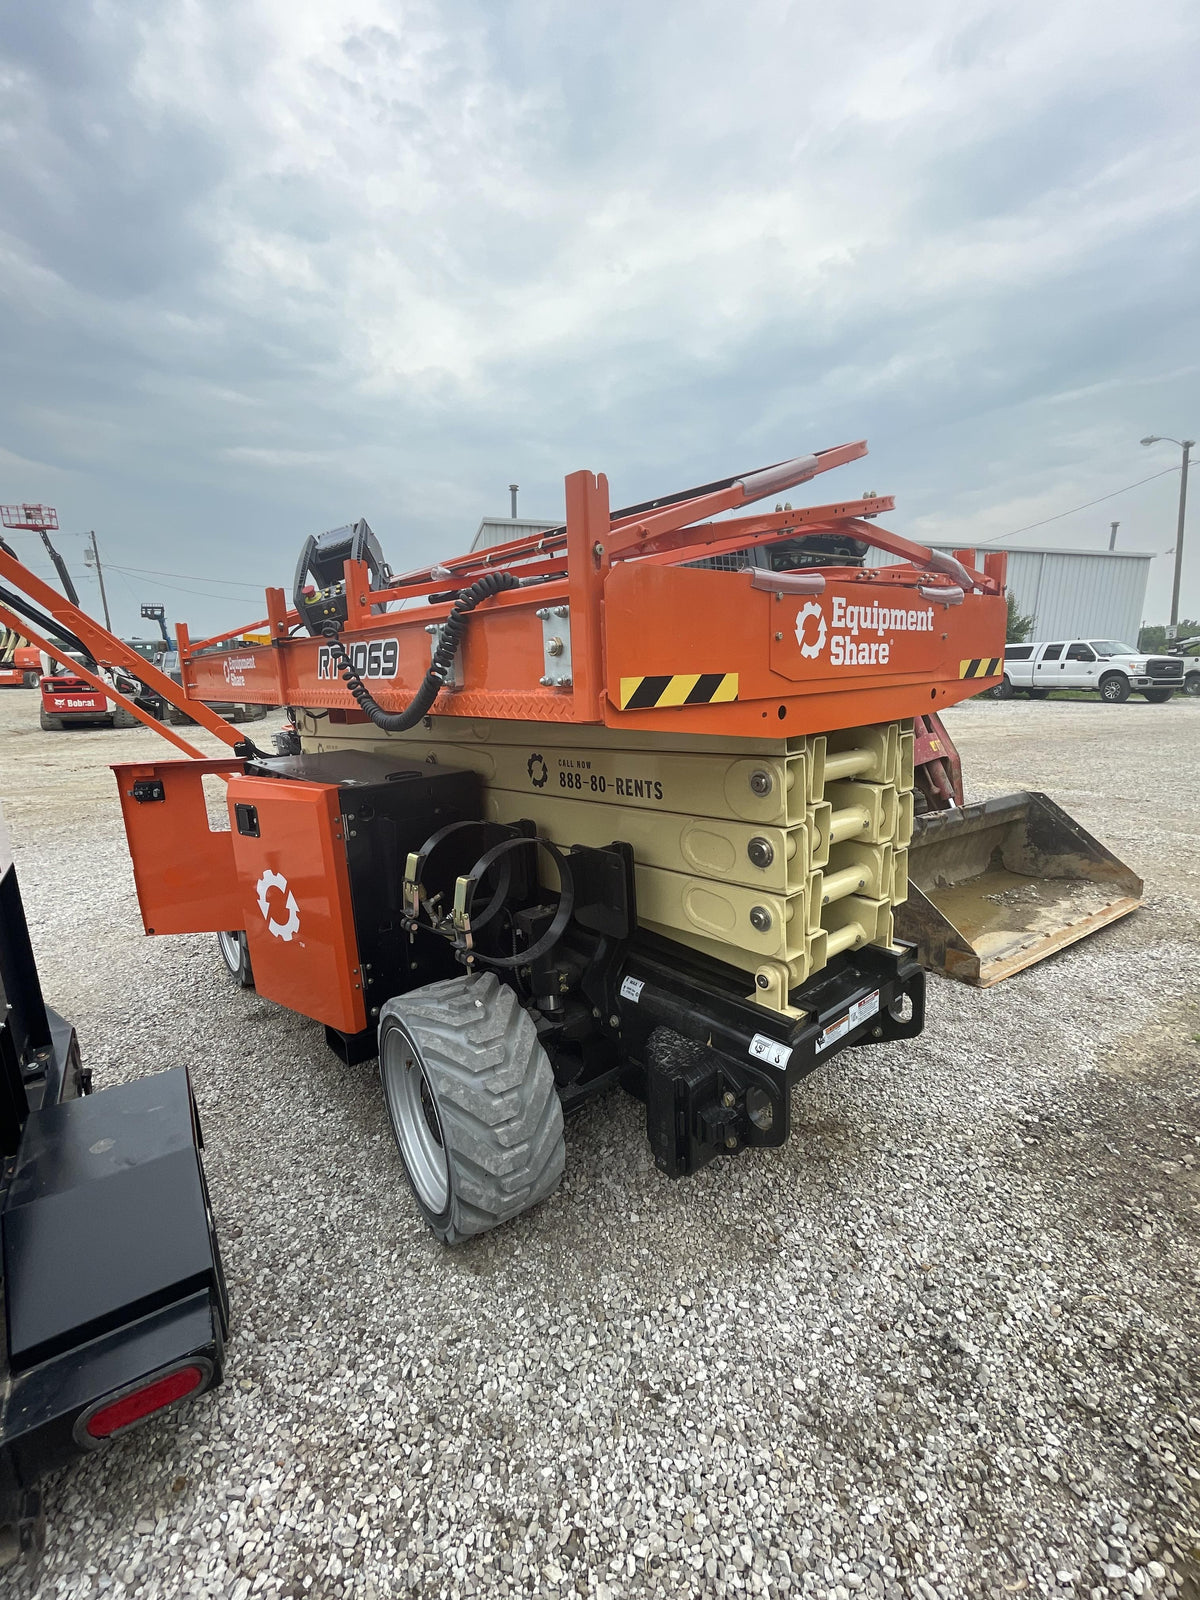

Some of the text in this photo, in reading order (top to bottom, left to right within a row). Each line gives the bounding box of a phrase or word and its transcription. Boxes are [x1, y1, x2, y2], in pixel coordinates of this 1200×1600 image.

[831, 596, 935, 637] Equipment
[830, 635, 890, 666] Share
[228, 654, 256, 673] Equipment
[230, 672, 245, 687] Share
[67, 699, 95, 707] Bobcat
[558, 759, 592, 770] CALL NOW
[559, 771, 664, 800] 888-80-RENTS
